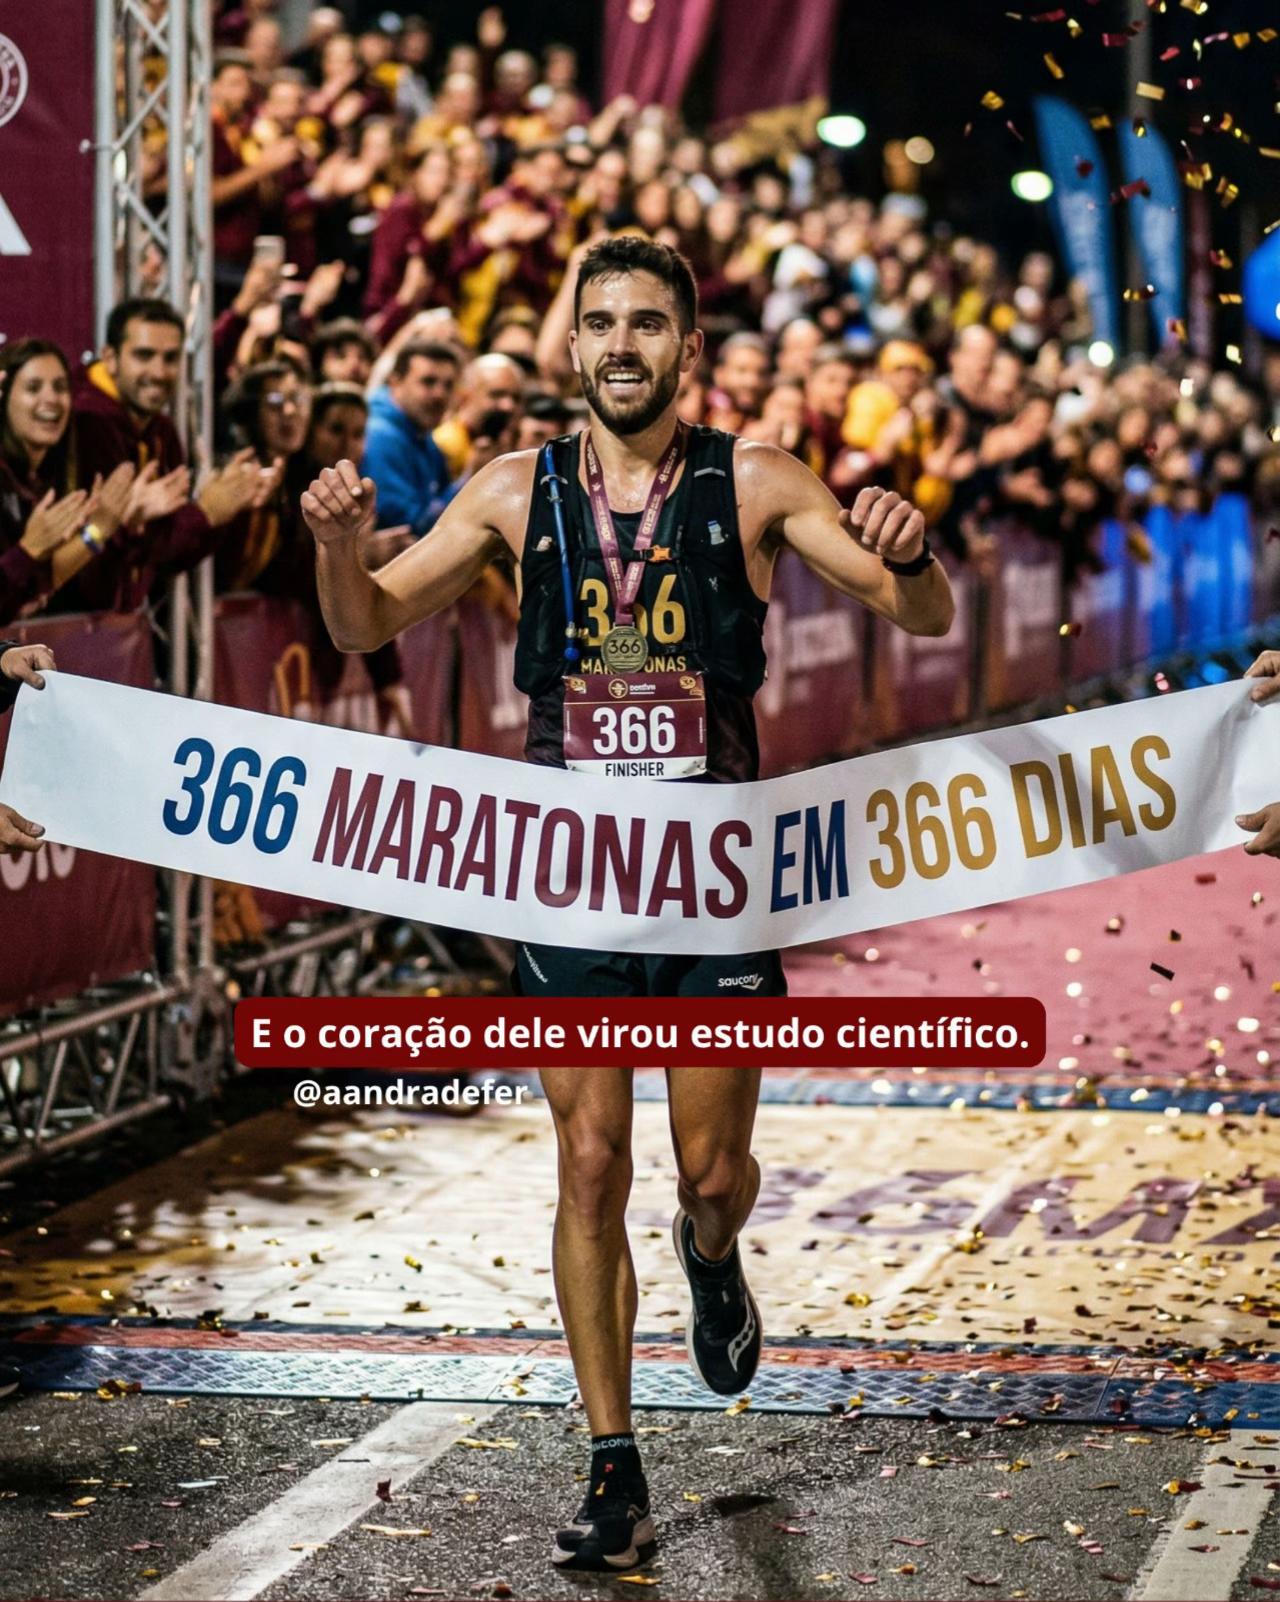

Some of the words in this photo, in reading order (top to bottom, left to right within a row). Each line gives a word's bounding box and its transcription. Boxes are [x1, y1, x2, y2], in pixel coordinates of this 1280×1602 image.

[608, 639, 641, 654] 366
[592, 705, 676, 755] 366
[605, 762, 664, 777] FINISHER
[163, 738, 306, 853] 366
[313, 768, 752, 918] MARATONAS
[770, 800, 849, 913] EM
[867, 775, 996, 888] 366
[1010, 736, 1176, 857] DIAS
